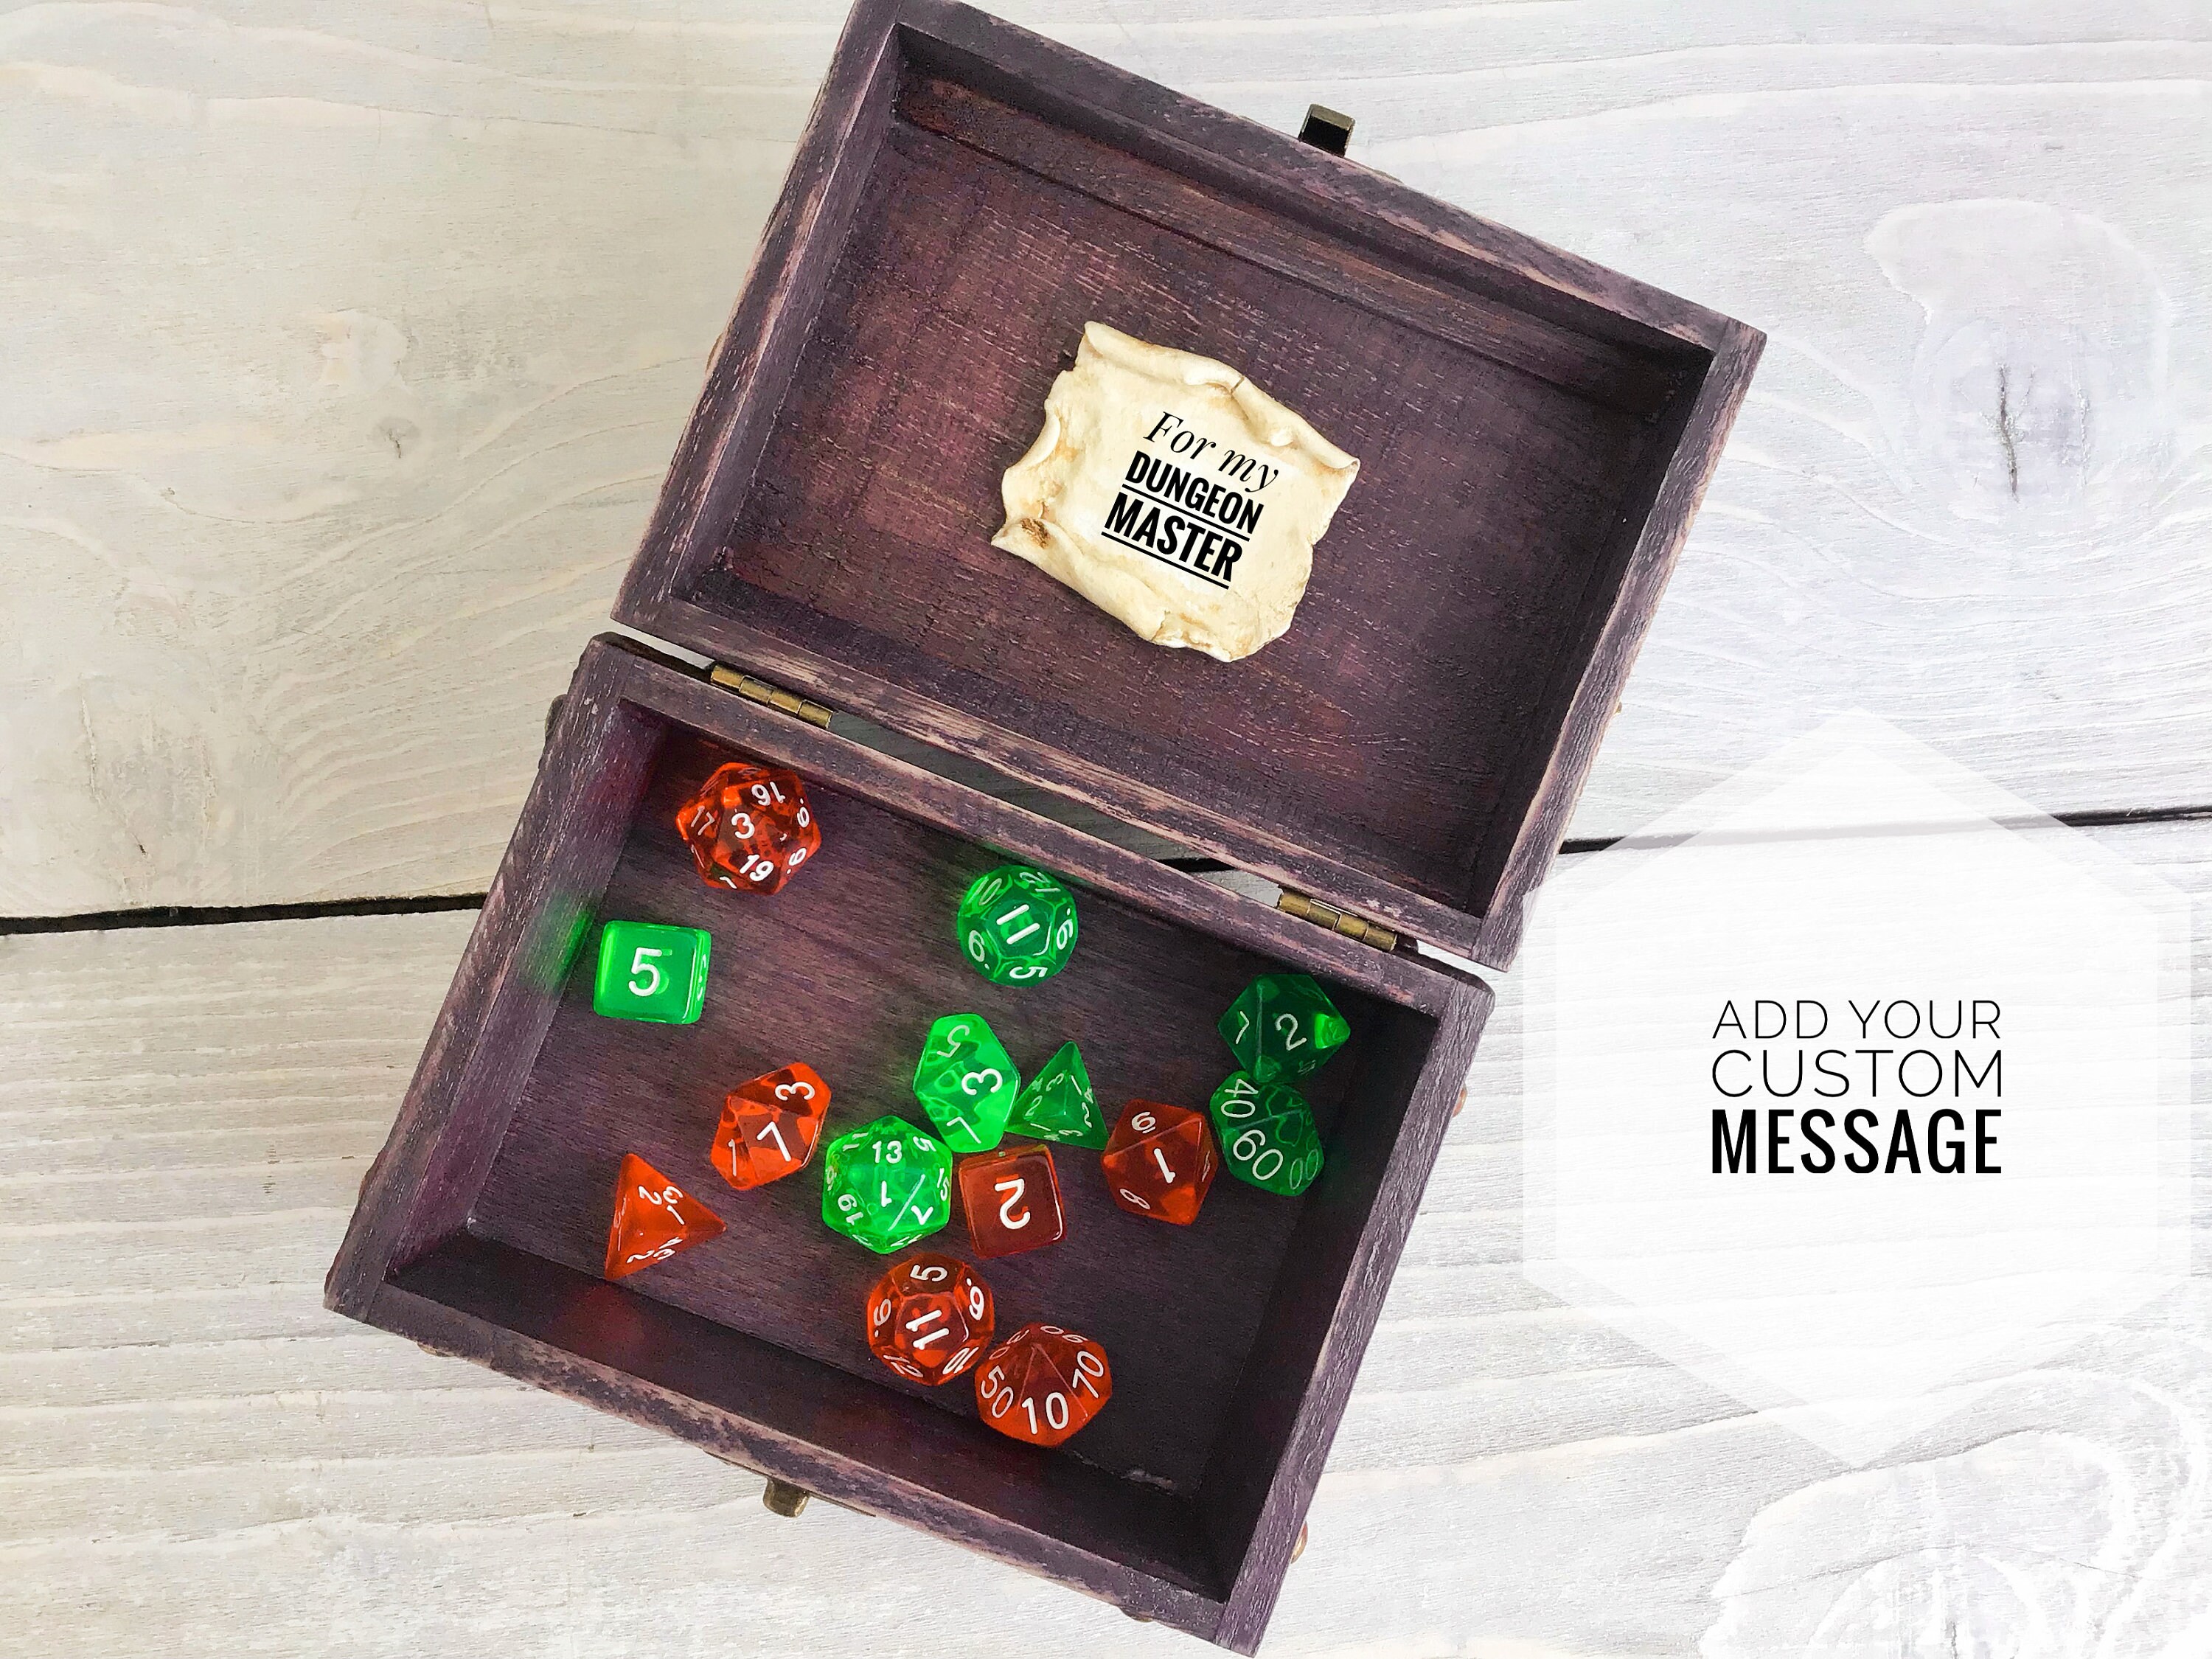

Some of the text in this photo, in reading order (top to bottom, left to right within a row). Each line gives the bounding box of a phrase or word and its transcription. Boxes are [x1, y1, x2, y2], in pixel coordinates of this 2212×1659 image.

[1144, 411, 1279, 493] For my
[1124, 451, 1265, 535] DUNGEON
[1104, 492, 1243, 582] MASTER
[731, 813, 755, 839] 3
[739, 854, 774, 881] 19
[996, 904, 1040, 945] 11
[628, 947, 663, 997] 5
[1275, 1013, 1307, 1051] 2
[774, 1082, 815, 1101] 3
[961, 1068, 1004, 1096] 3
[1220, 1078, 1259, 1119] 40
[757, 1121, 792, 1162] 7
[872, 1140, 902, 1164] 13
[1233, 1129, 1284, 1180] 60
[1153, 1148, 1176, 1183] 1
[994, 1178, 1031, 1230] 2
[1119, 1188, 1151, 1210] 8
[910, 1265, 947, 1281] 5
[905, 1310, 950, 1350] 11
[981, 1365, 1014, 1419] 50
[1072, 1351, 1104, 1399] 70
[1022, 1391, 1069, 1435] 10
